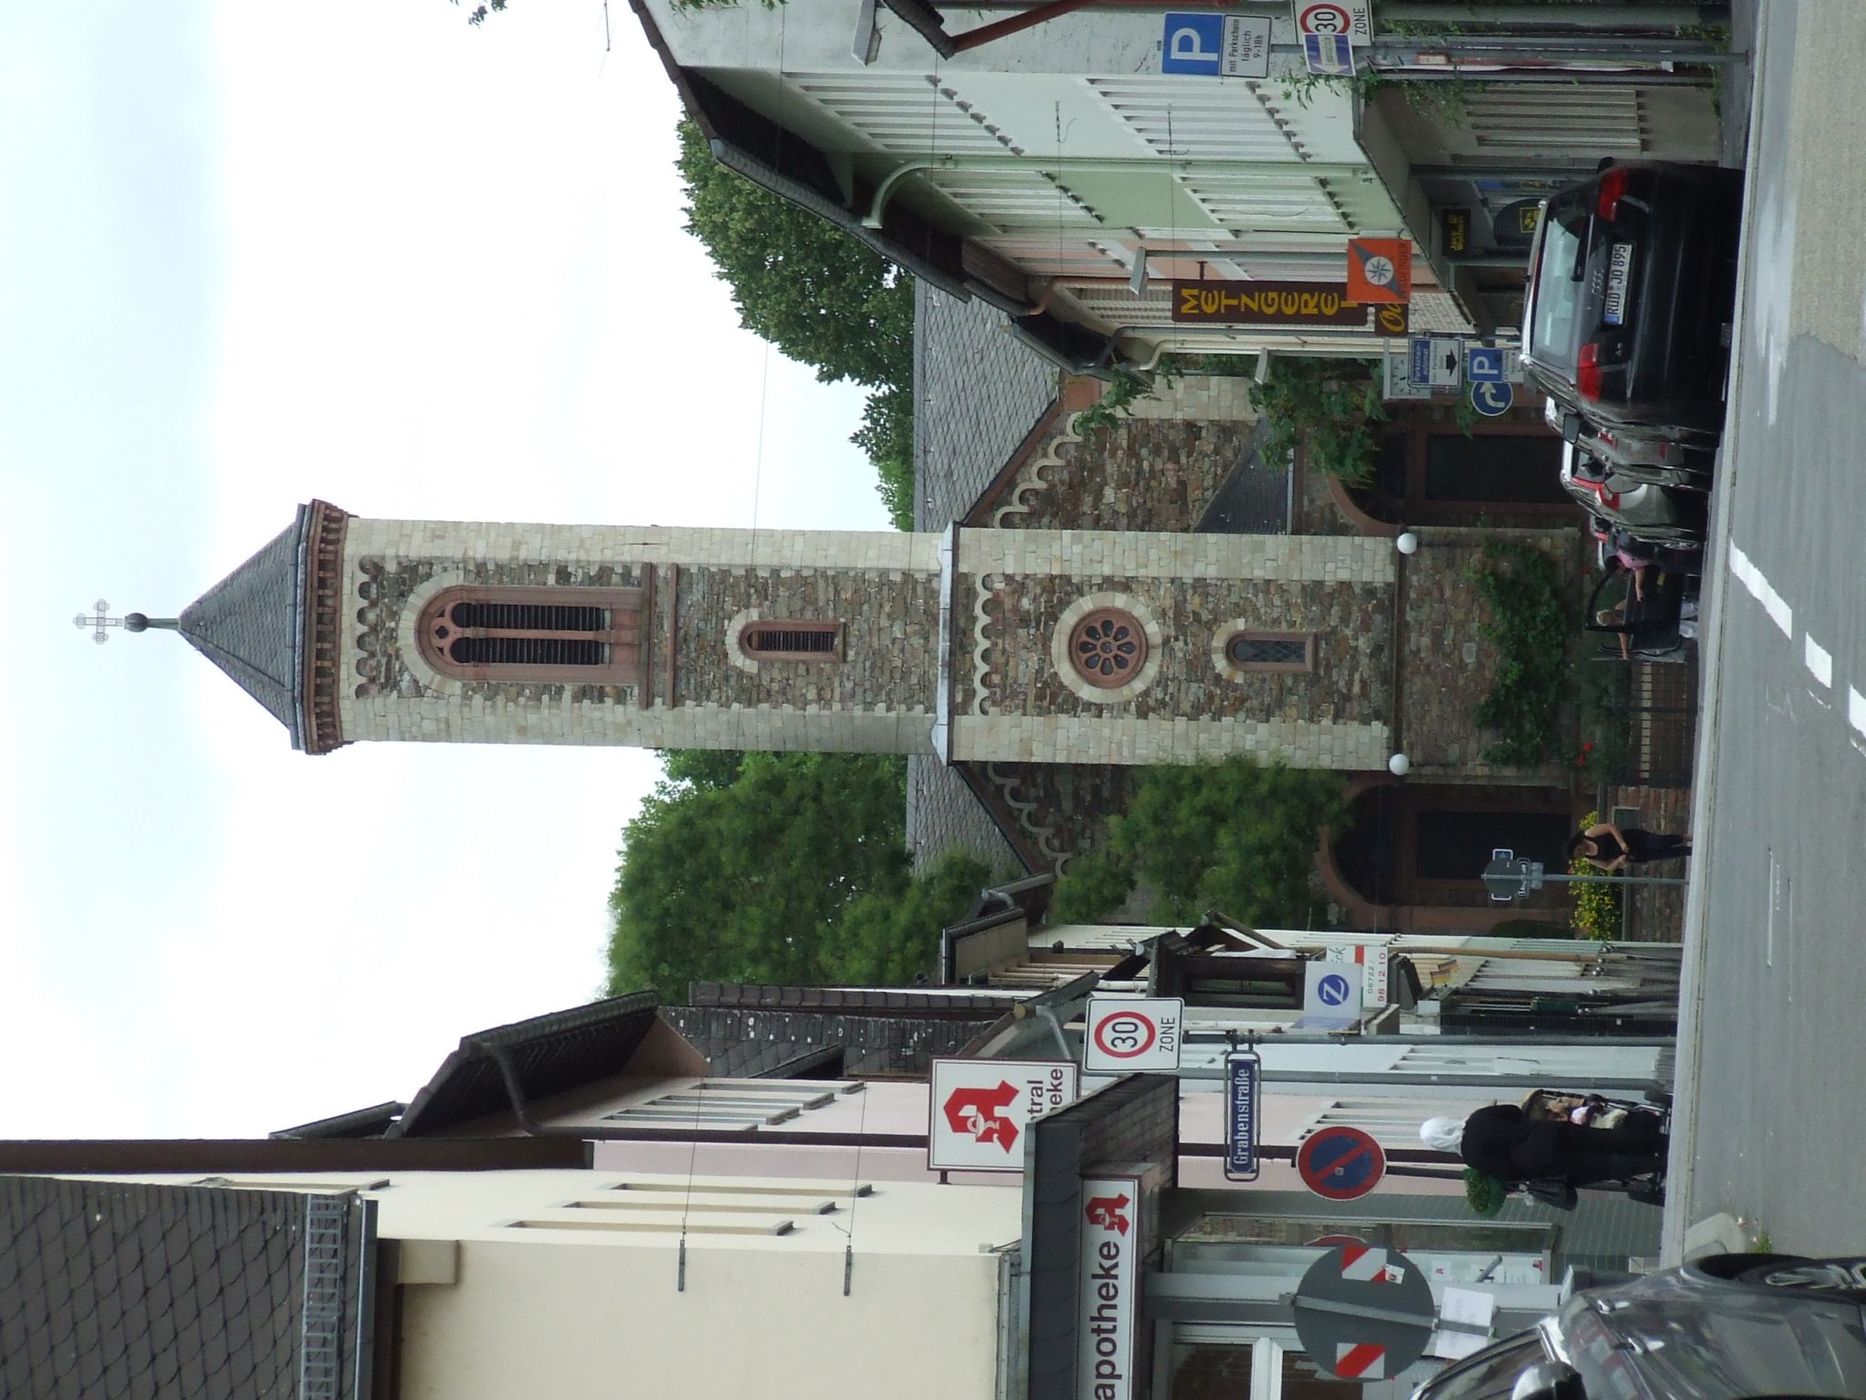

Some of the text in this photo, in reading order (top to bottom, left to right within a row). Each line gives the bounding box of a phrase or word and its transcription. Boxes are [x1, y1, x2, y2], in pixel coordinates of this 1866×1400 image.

[1314, 11, 1338, 33] 30
[1353, 7, 1368, 36] ZONE
[1170, 27, 1219, 62] P
[1228, 18, 1241, 73] mit Parkschein
[1241, 29, 1253, 62] täglich
[1252, 33, 1264, 59] 9-18h
[1611, 245, 1627, 268] 895
[1472, 355, 1499, 375] P
[1377, 952, 1387, 1002] 98 12 10
[1110, 1021, 1139, 1049] 30
[1159, 1016, 1176, 1052] ZONE
[1046, 1068, 1063, 1110] eke
[1232, 1067, 1251, 1165] Grabenstraße
[1089, 1240, 1122, 1400] apotheke
